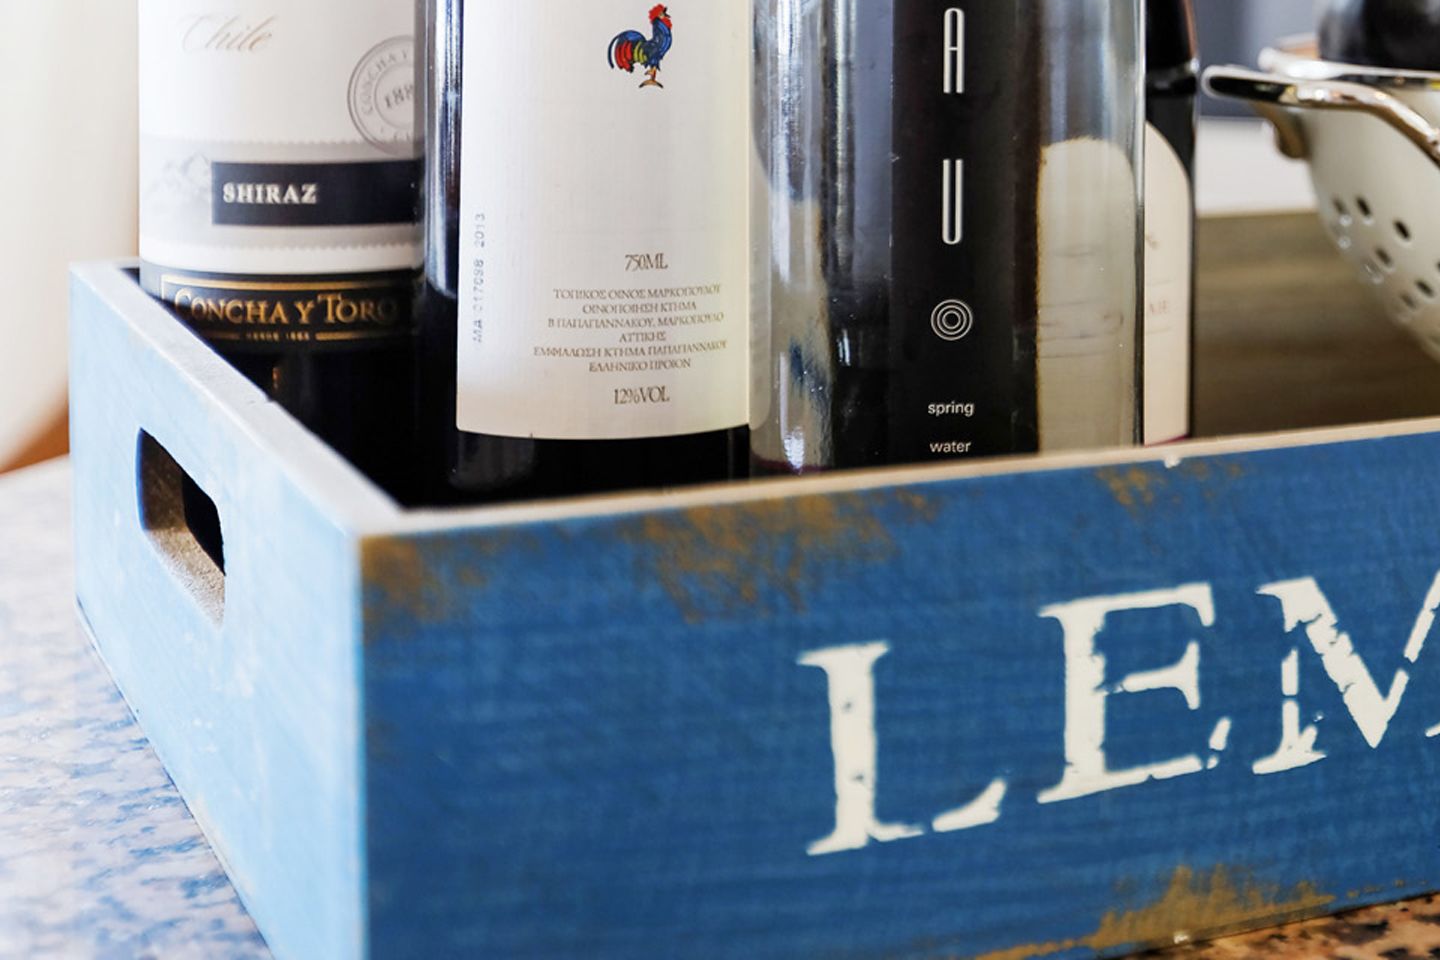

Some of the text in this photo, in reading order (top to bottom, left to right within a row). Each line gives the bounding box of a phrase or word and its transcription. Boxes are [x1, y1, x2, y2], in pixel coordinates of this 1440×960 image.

[177, 13, 280, 53] Chile
[222, 183, 319, 205] SHIRAZ
[625, 252, 669, 272] 750ML
[175, 287, 288, 325] CONCHA
[295, 300, 315, 325] Y
[928, 400, 974, 418] spring
[929, 440, 971, 454] water
